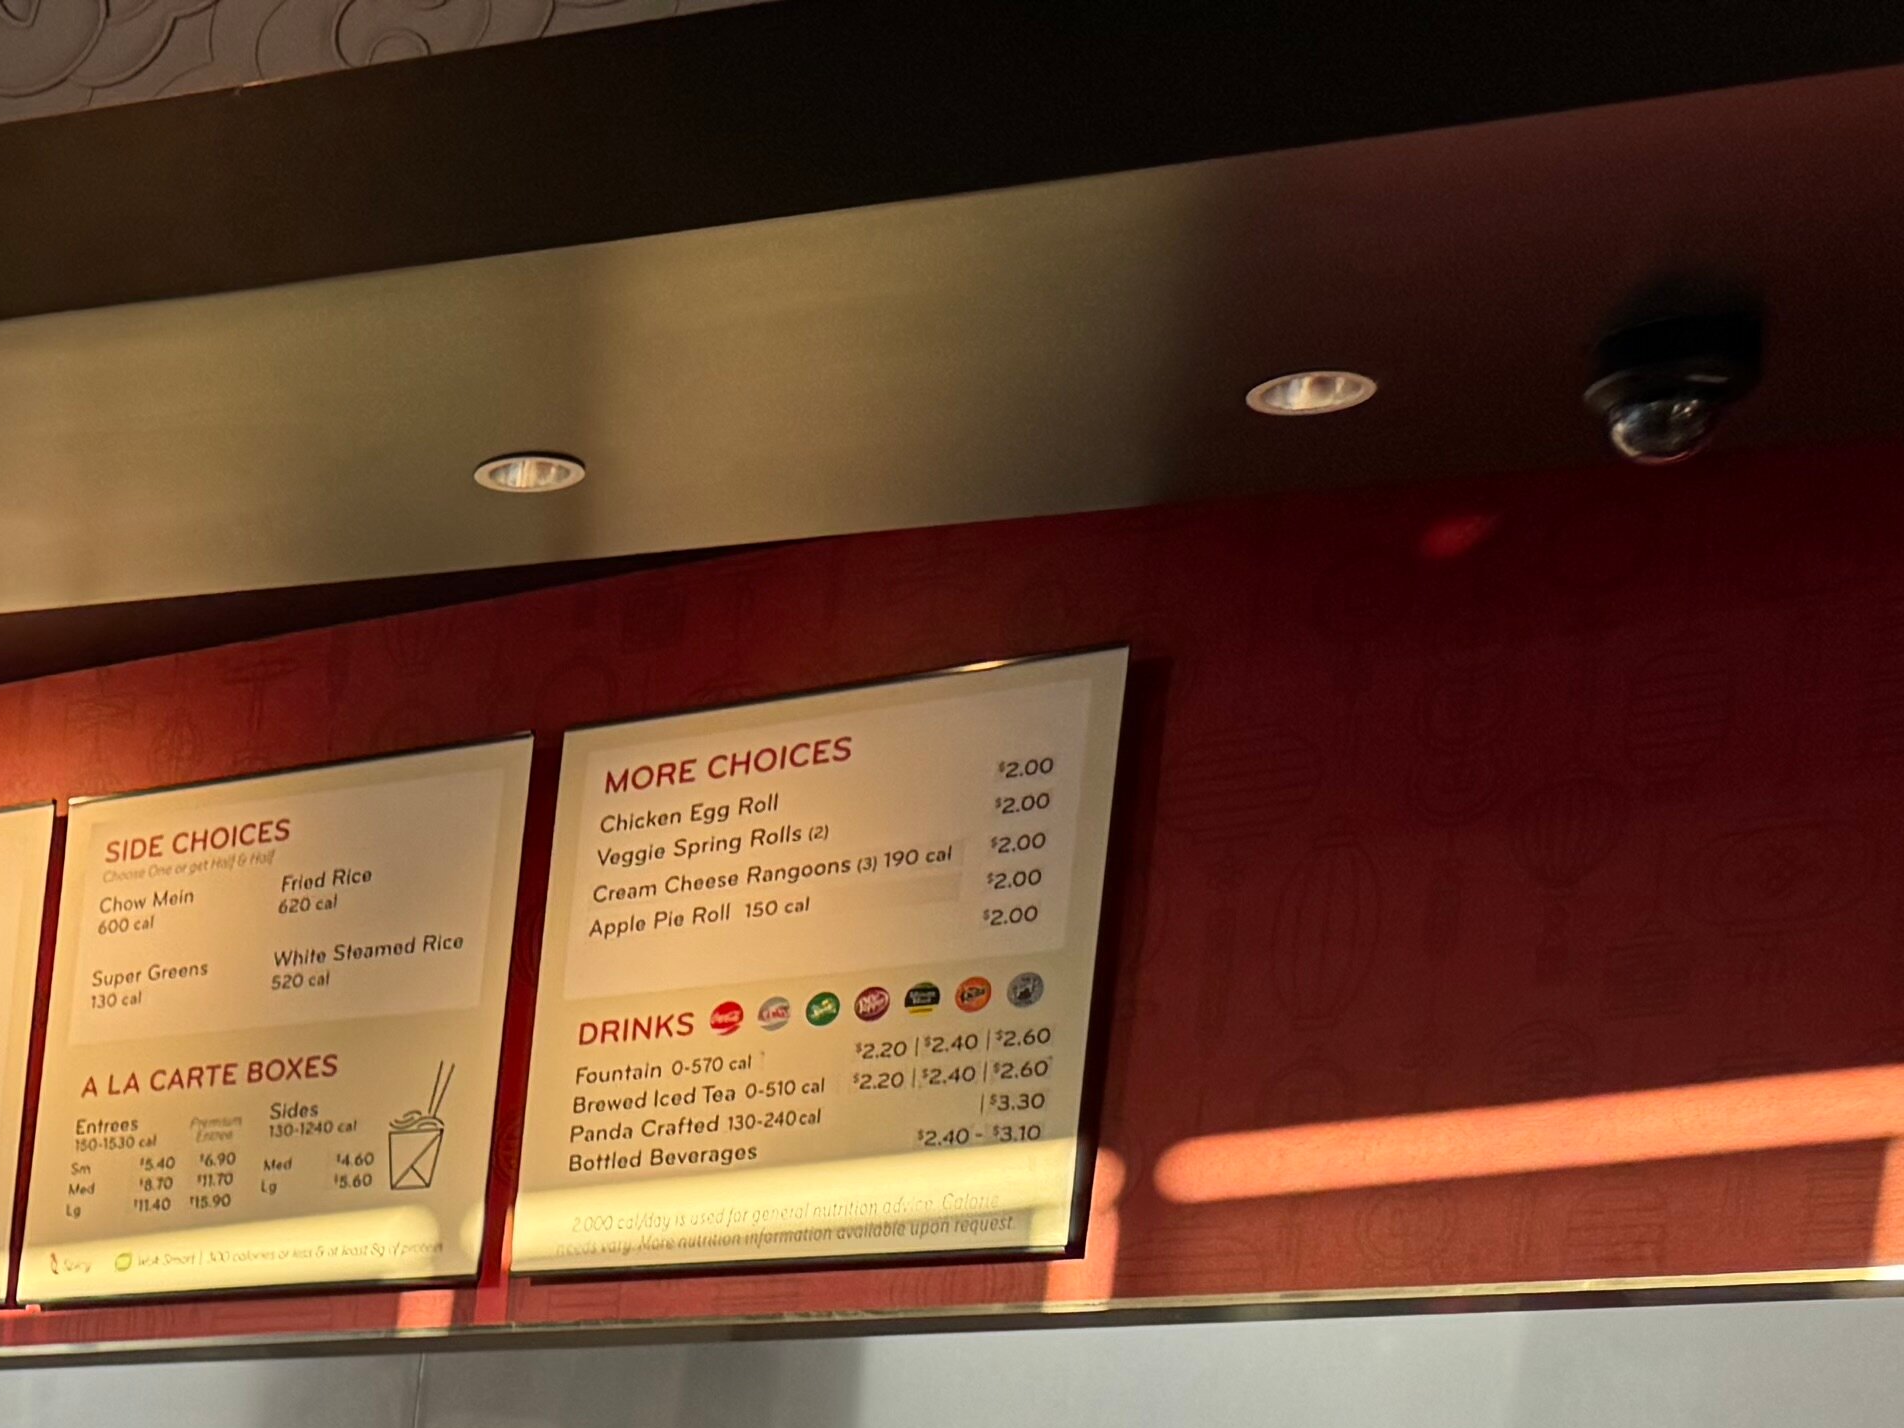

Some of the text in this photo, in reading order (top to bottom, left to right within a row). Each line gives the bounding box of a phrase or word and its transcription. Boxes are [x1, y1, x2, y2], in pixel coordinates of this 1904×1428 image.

[604, 735, 853, 795] MORE CHOICES
[599, 792, 779, 834] Chicken Egg Roll
[105, 817, 291, 863] SIDE CHOICES
[597, 824, 830, 868] Veggie Spring Rolls (2)
[281, 868, 373, 893] Fried Rice
[592, 844, 953, 904] Cream Cheese Rangoons (3) 190 cal
[99, 889, 195, 914] Chow Mein
[588, 895, 810, 940] Apple Pie Roll 150 cal
[274, 934, 464, 967] White Steamed Rice
[91, 963, 209, 989] Super Greens
[578, 1012, 695, 1046] DRINKS
[81, 1053, 338, 1098] A LA CARTE BOXES
[575, 1054, 752, 1085] Fountain 0-570 cal
[572, 1076, 826, 1115] Brewed Iced Tea 0-510 cal
[569, 1107, 822, 1144] Panda Crafted 130-240 cal
[568, 1146, 758, 1173] Bottled Beverages
